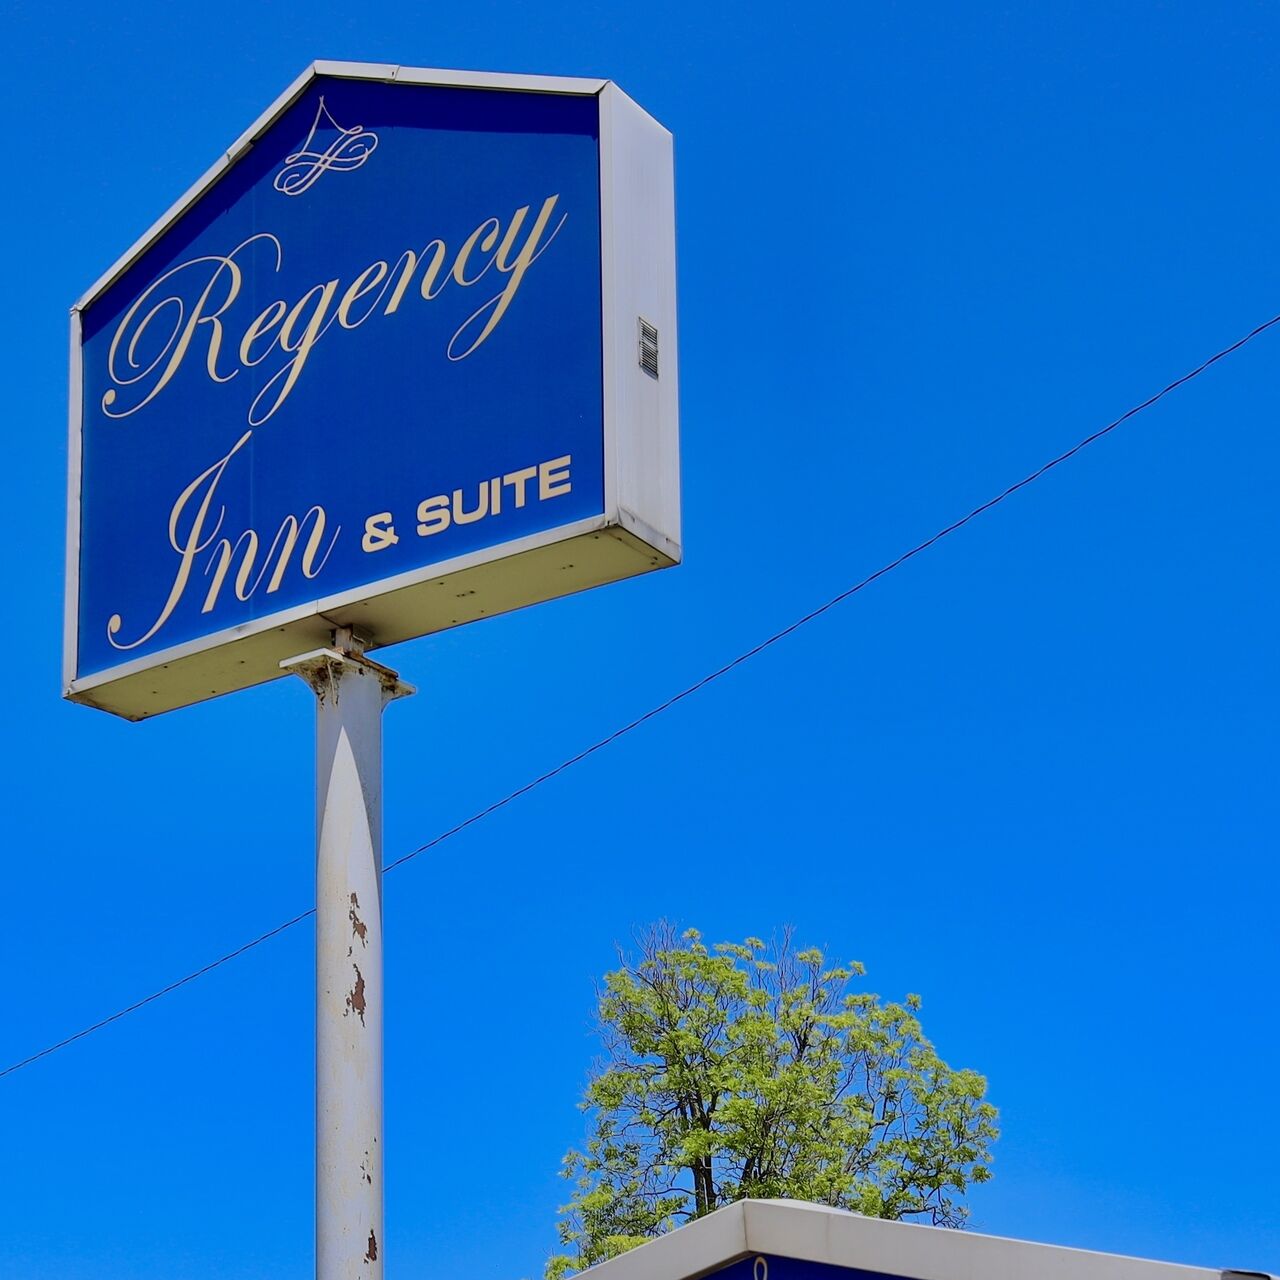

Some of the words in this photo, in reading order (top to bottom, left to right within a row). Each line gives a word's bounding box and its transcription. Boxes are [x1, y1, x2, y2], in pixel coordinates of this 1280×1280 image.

[101, 193, 568, 427] Regency
[106, 430, 340, 650] Inn
[361, 512, 400, 553] &
[416, 454, 572, 537] SUITE
